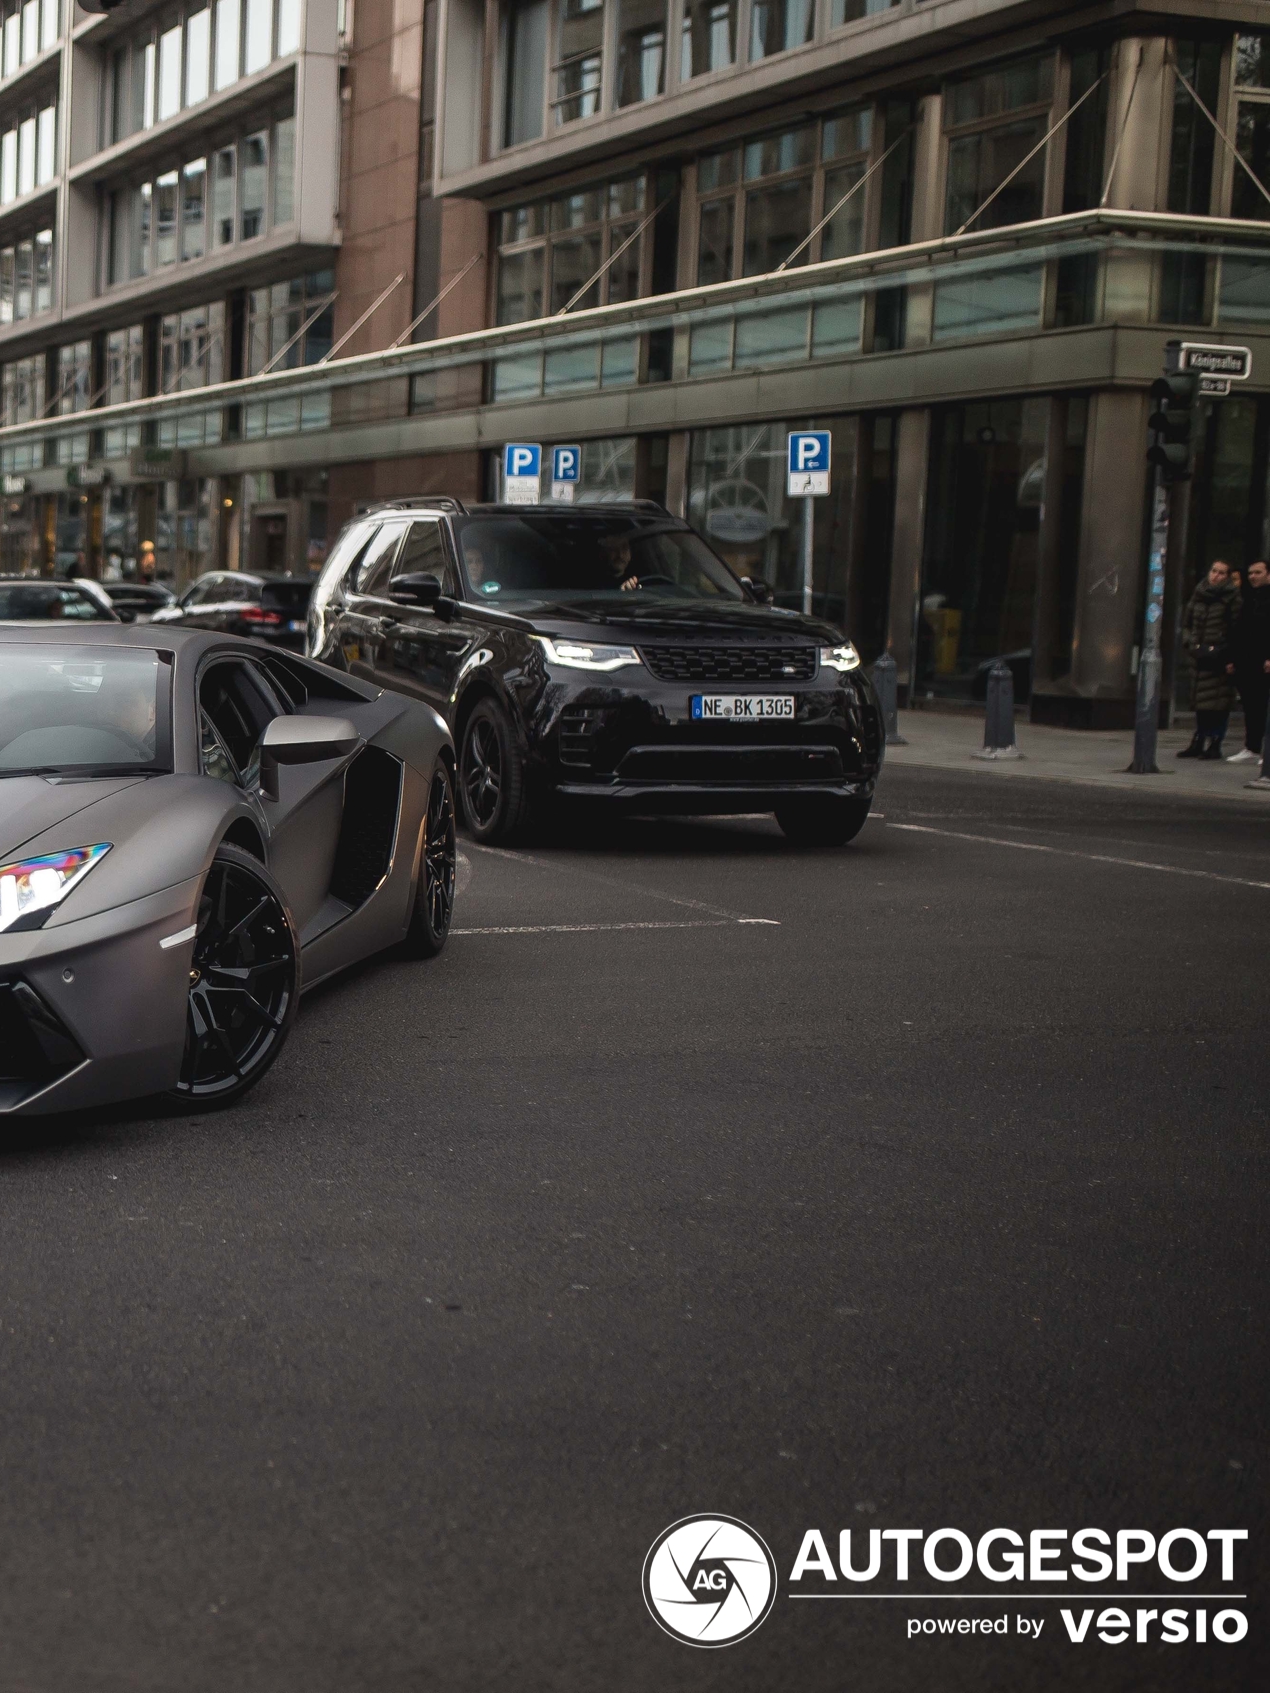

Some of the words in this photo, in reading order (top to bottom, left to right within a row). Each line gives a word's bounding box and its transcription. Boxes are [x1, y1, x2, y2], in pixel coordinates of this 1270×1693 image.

[513, 448, 533, 475] P
[558, 450, 574, 478] P
[799, 436, 821, 470] P
[703, 698, 723, 716] NE
[734, 698, 753, 716] BK
[756, 698, 793, 716] 1305
